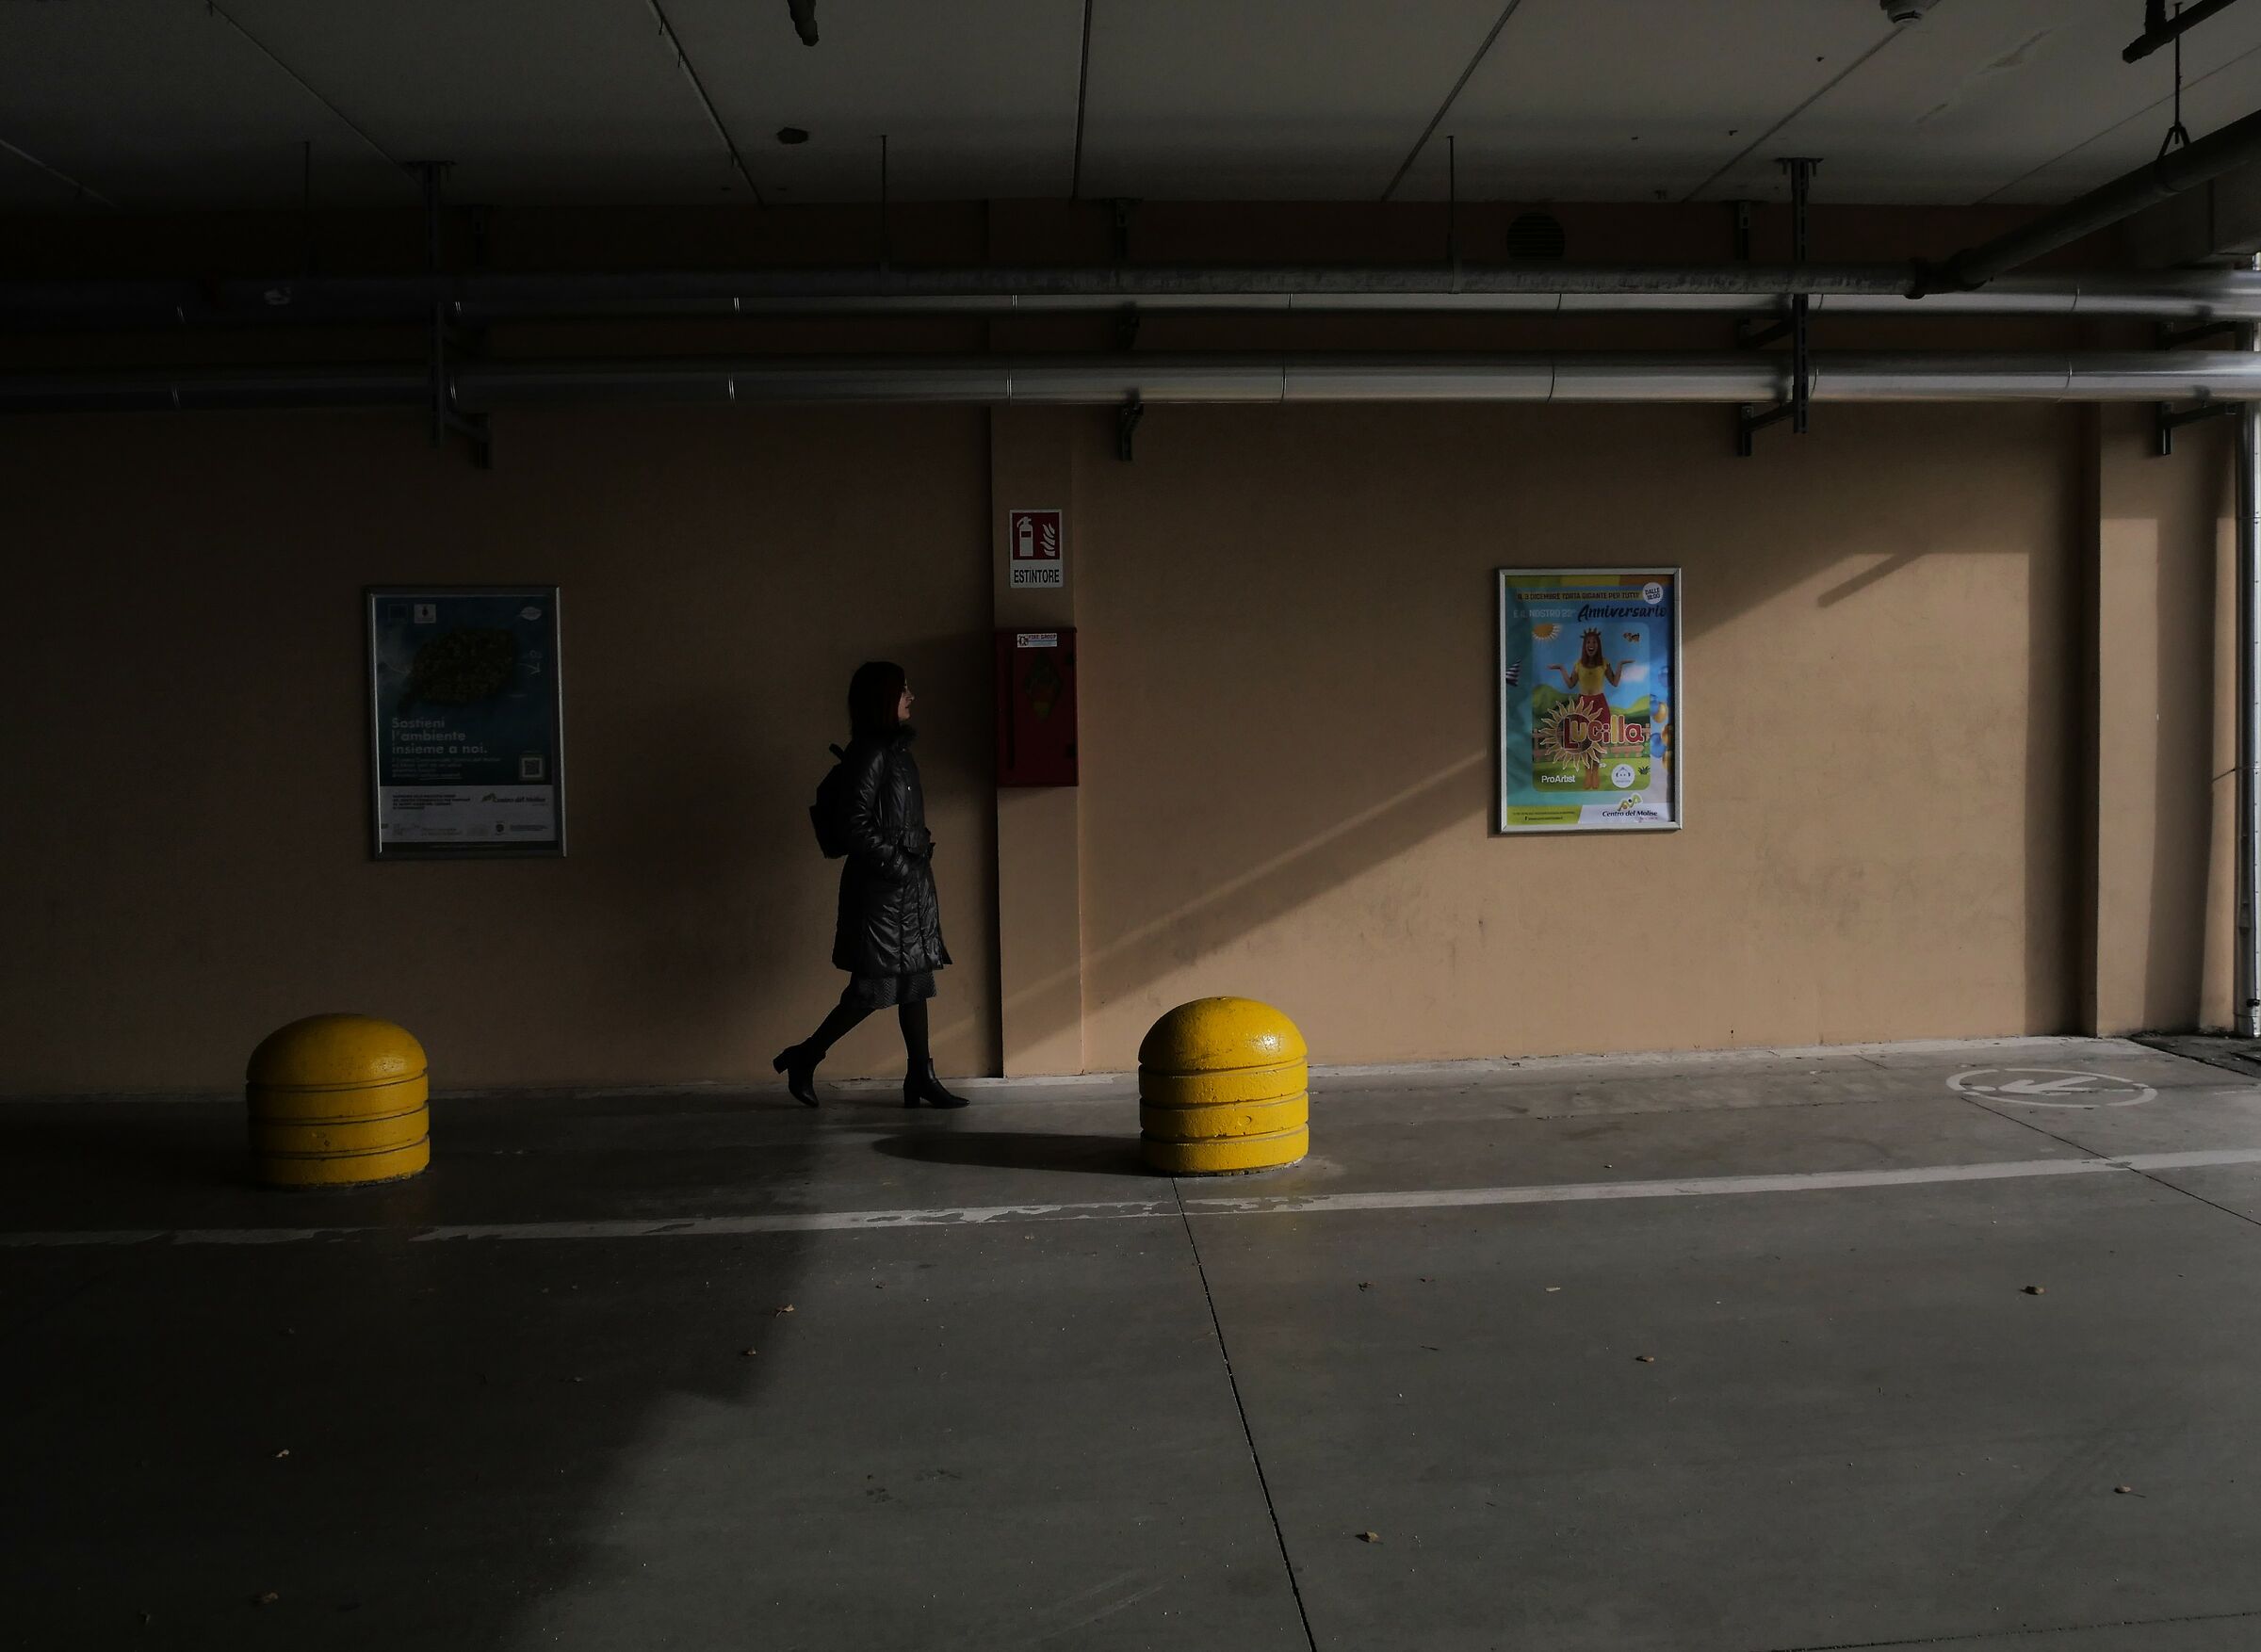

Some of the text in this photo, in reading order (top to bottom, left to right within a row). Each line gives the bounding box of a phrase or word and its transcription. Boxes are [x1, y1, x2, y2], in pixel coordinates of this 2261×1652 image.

[1014, 569, 1059, 583] ESTINTORE
[1645, 587, 1660, 595] DALLE
[1529, 609, 1561, 618] NOSTRO
[1577, 604, 1667, 622] Anniversario
[391, 717, 445, 728] Sostieni
[391, 729, 466, 741] l'ambiente
[1563, 714, 1645, 751] Lucilla
[392, 742, 488, 753] insieme a noi.
[1541, 774, 1576, 783] ProArtist
